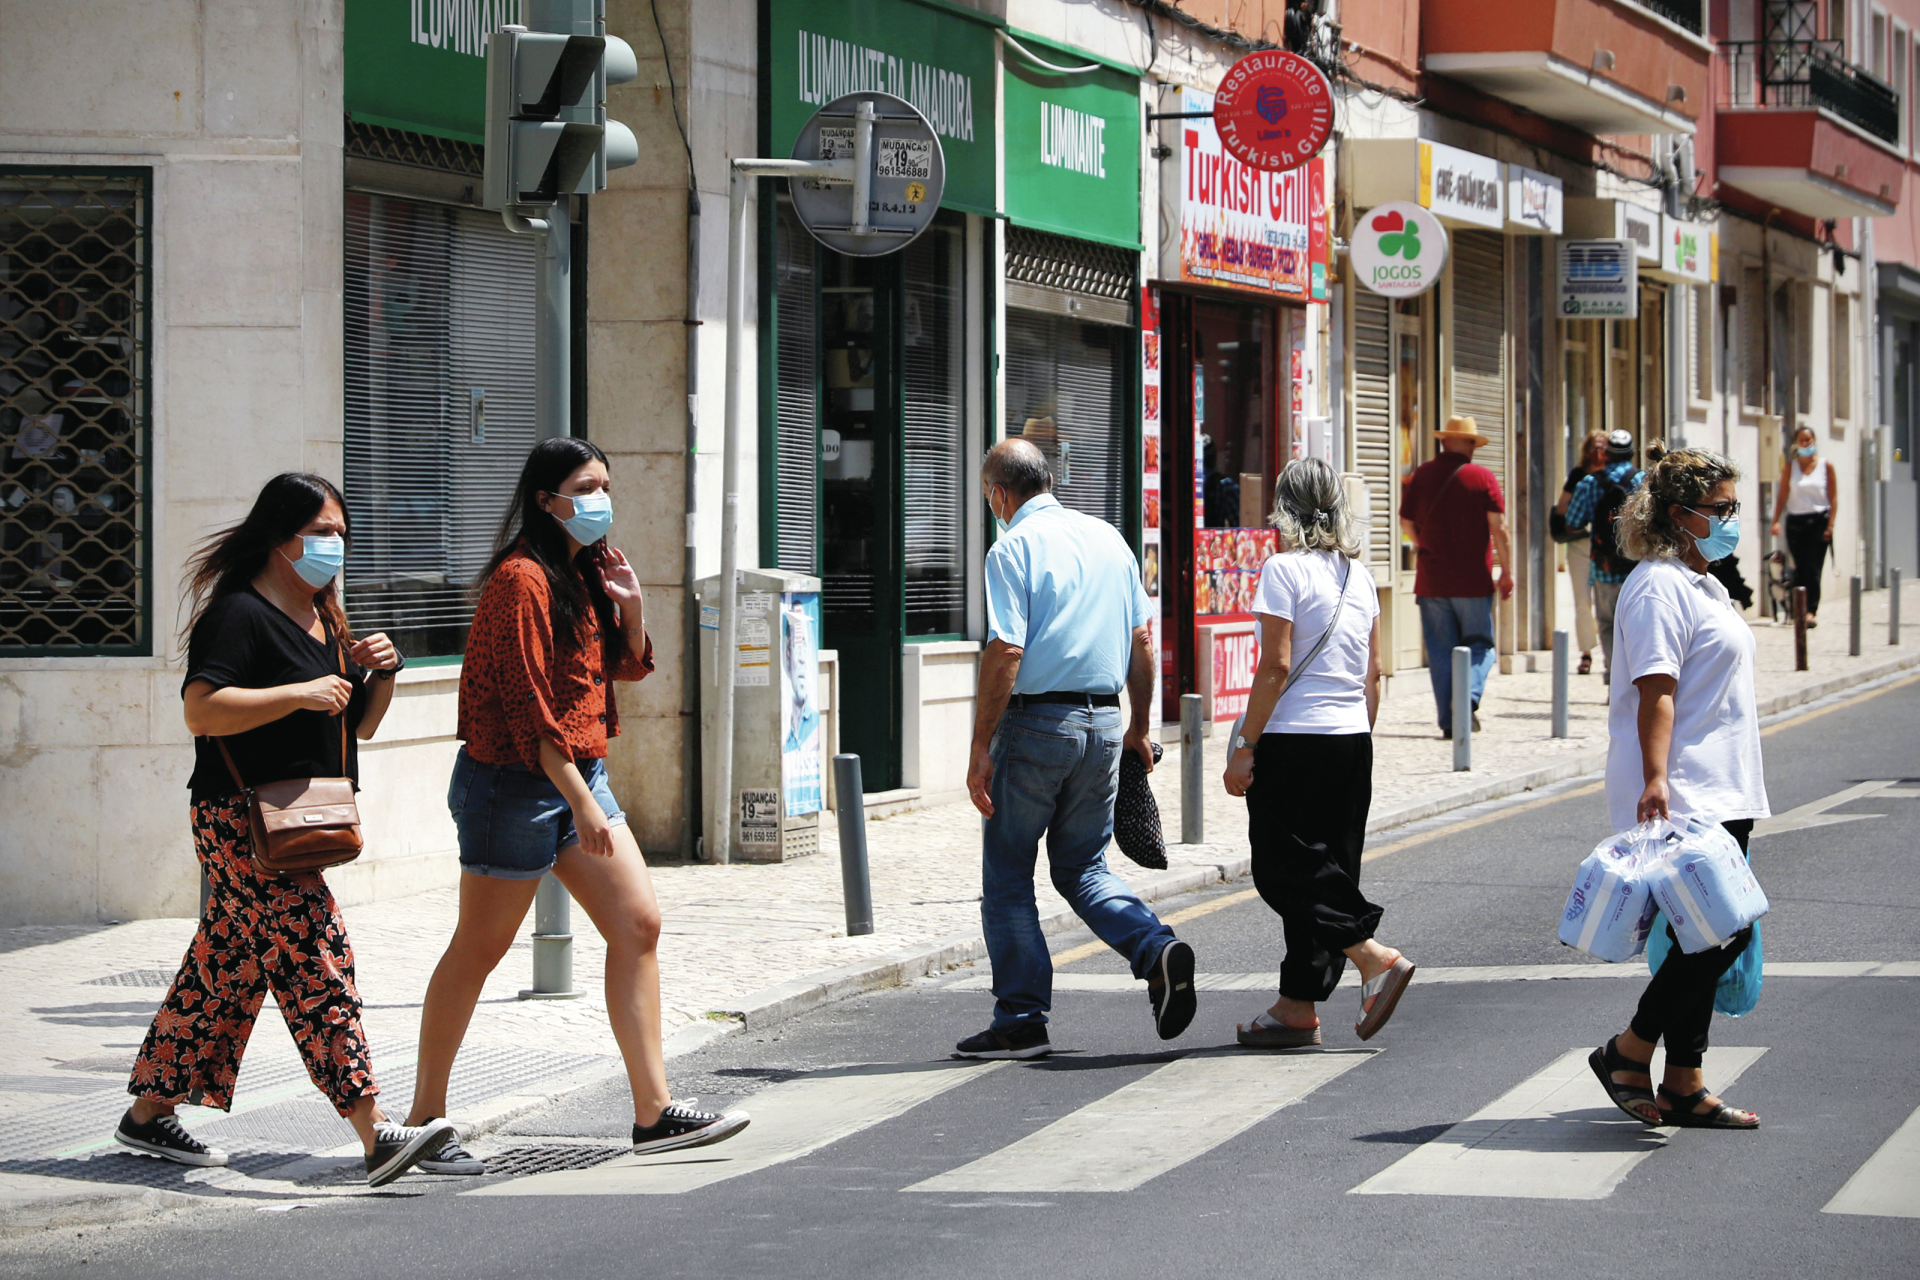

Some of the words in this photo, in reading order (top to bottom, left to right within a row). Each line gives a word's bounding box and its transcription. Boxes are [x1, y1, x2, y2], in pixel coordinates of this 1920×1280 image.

[799, 29, 885, 105] ILUMINANTE
[910, 61, 975, 142] AMADORA
[1217, 56, 1321, 106] Restaurante
[1041, 101, 1105, 179] ILUMINANTE
[1222, 119, 1295, 168] Turkish
[1297, 108, 1327, 155] Grill
[878, 165, 929, 178] 961546888
[1185, 128, 1262, 217] Turkish
[1268, 161, 1307, 226] Grill
[1372, 264, 1422, 284] JOGOS
[1582, 300, 1623, 308] CAIXA
[1224, 633, 1255, 691] TAKE
[741, 792, 777, 806] MUDANÇAS
[741, 803, 756, 819] 19
[742, 831, 753, 842] 961
